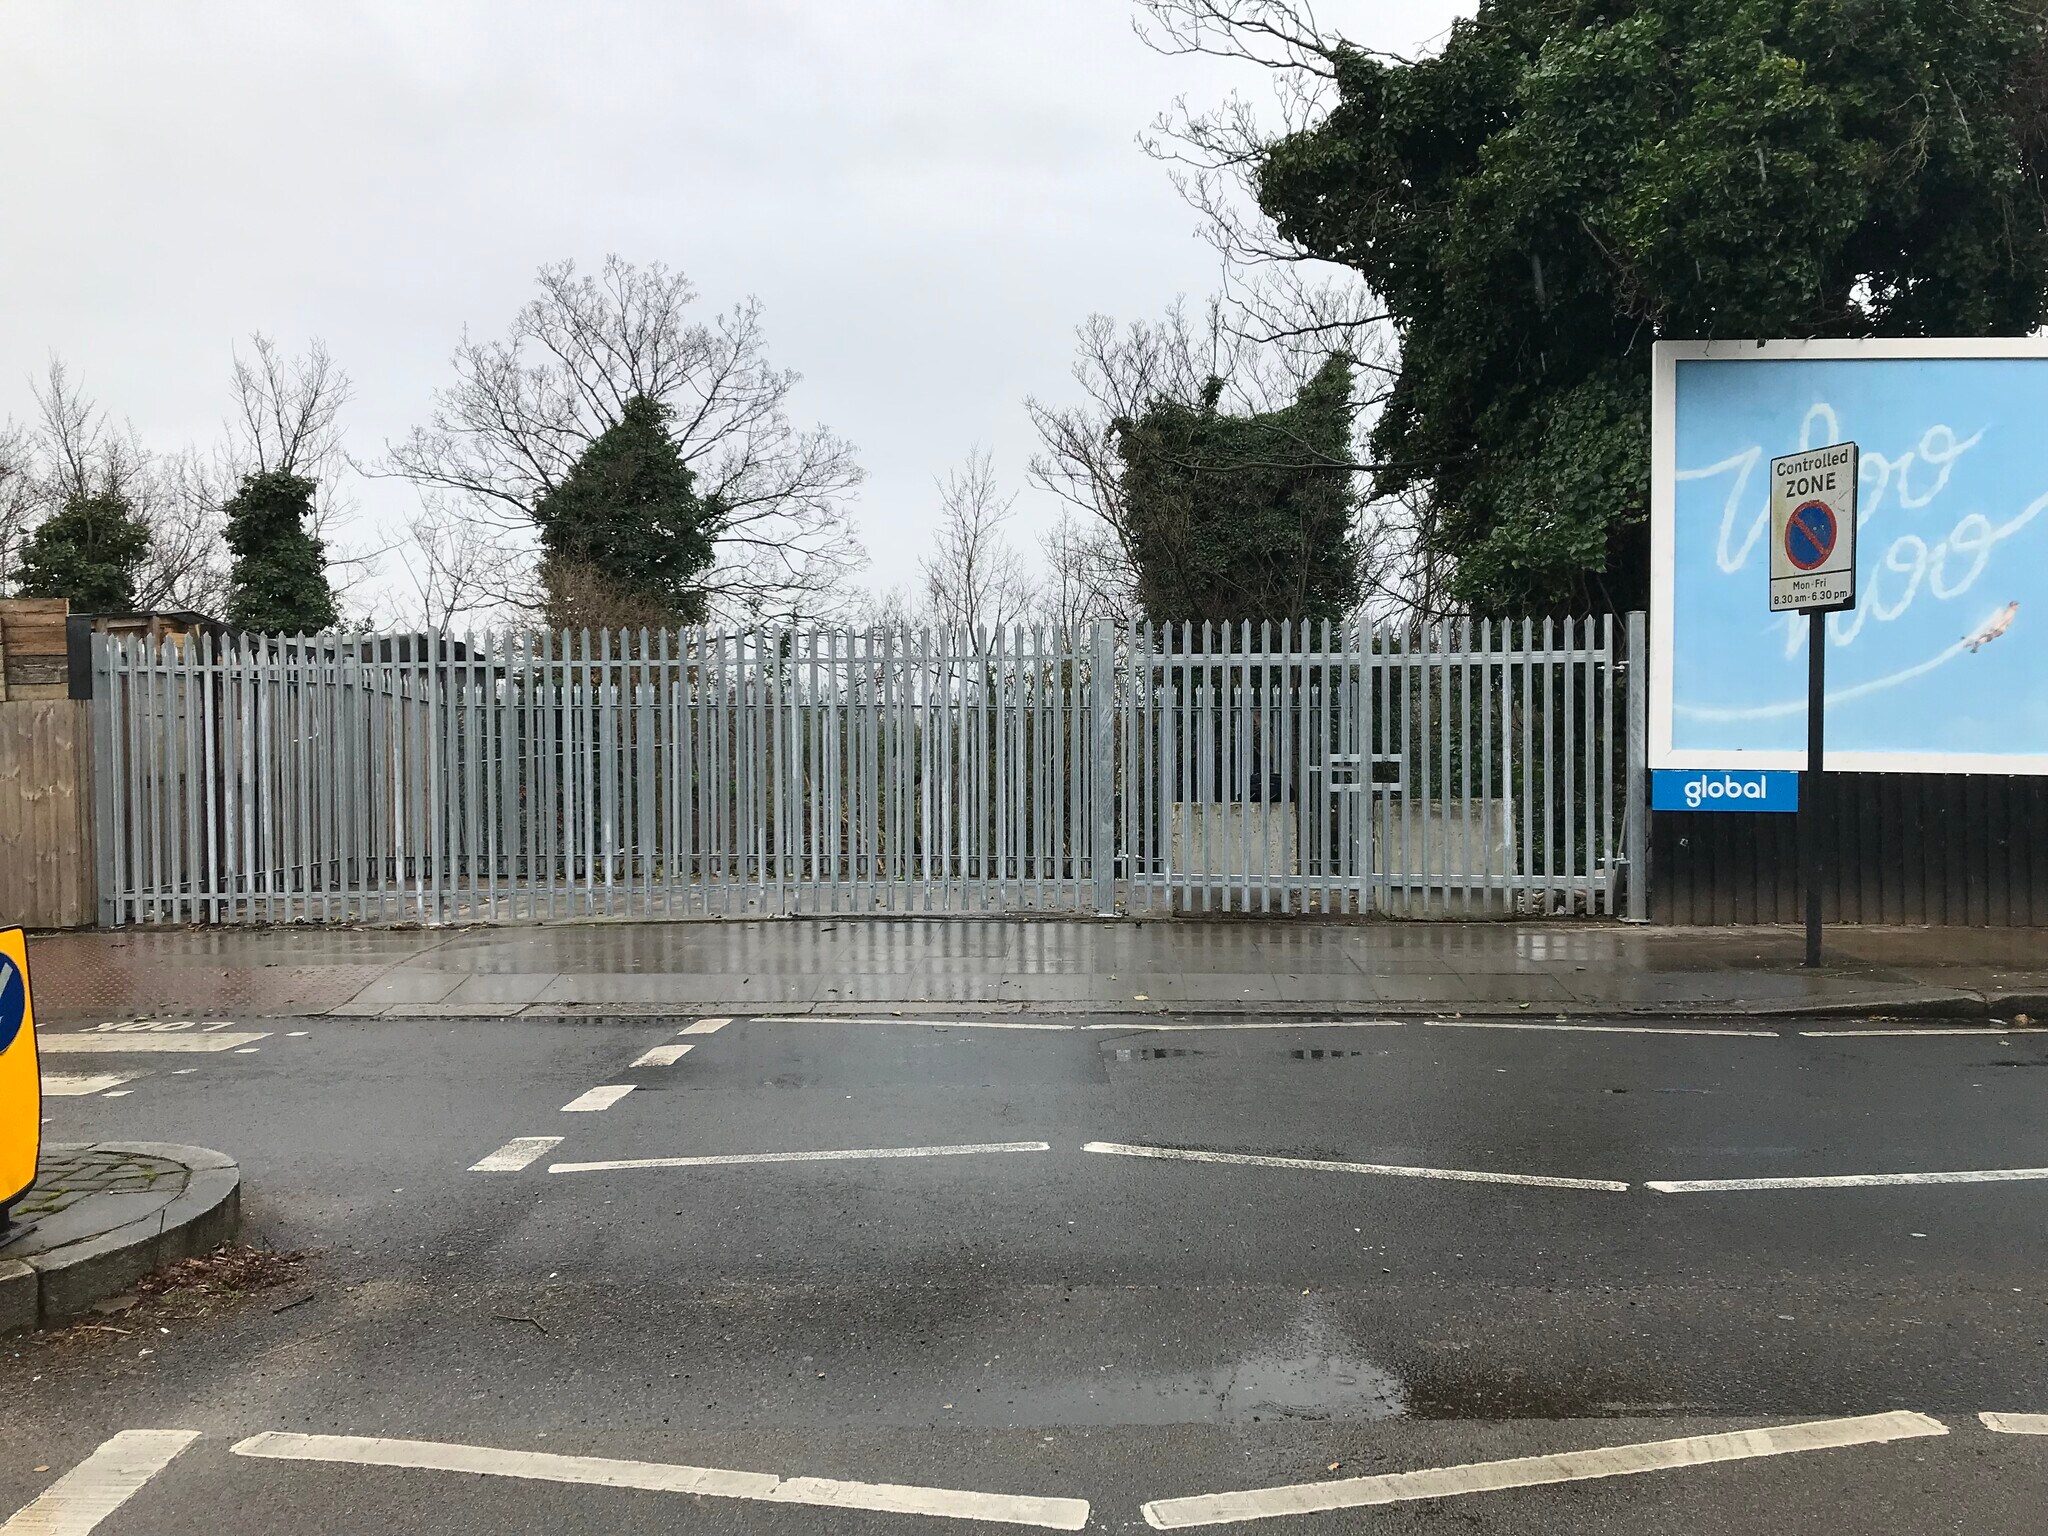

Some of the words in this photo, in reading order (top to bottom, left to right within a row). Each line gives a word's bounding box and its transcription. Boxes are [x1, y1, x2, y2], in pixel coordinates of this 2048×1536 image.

[1777, 449, 1848, 477] Controlled
[1786, 472, 1837, 498] ZONE
[1773, 594, 1793, 605] 8.30
[1834, 590, 1848, 600] pm
[1684, 774, 1767, 808] global
